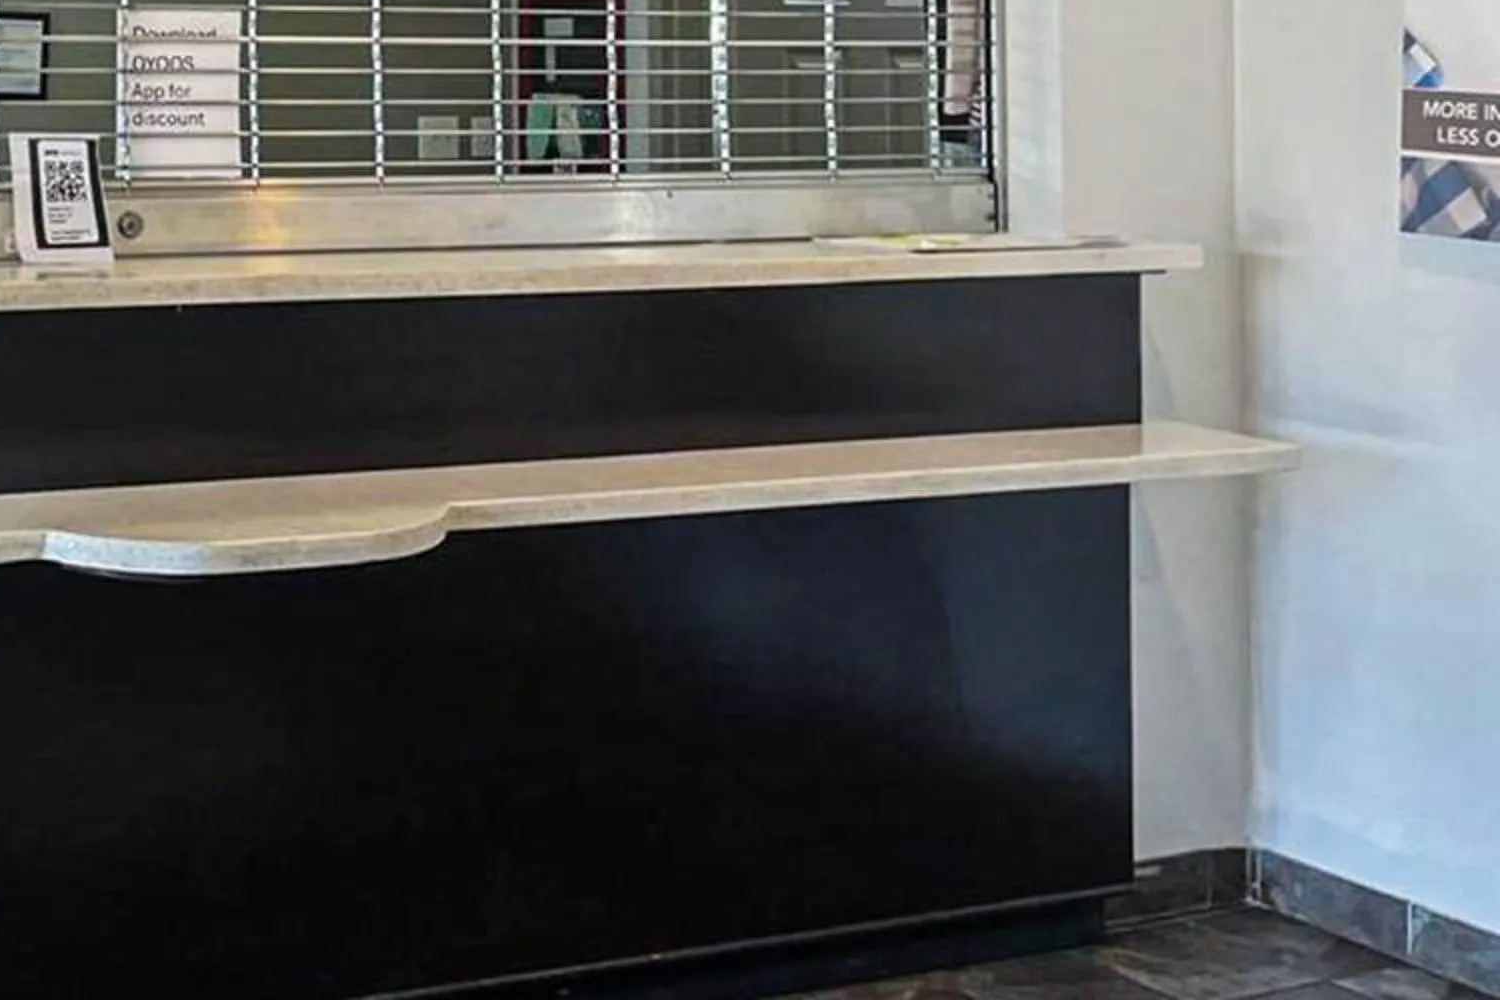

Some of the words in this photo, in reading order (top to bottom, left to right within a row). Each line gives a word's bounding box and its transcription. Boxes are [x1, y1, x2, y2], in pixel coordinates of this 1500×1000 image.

[131, 83, 165, 102] App
[168, 83, 192, 98] for
[131, 111, 206, 127] discount
[1423, 100, 1477, 120] MORE
[1436, 126, 1480, 146] LESS
